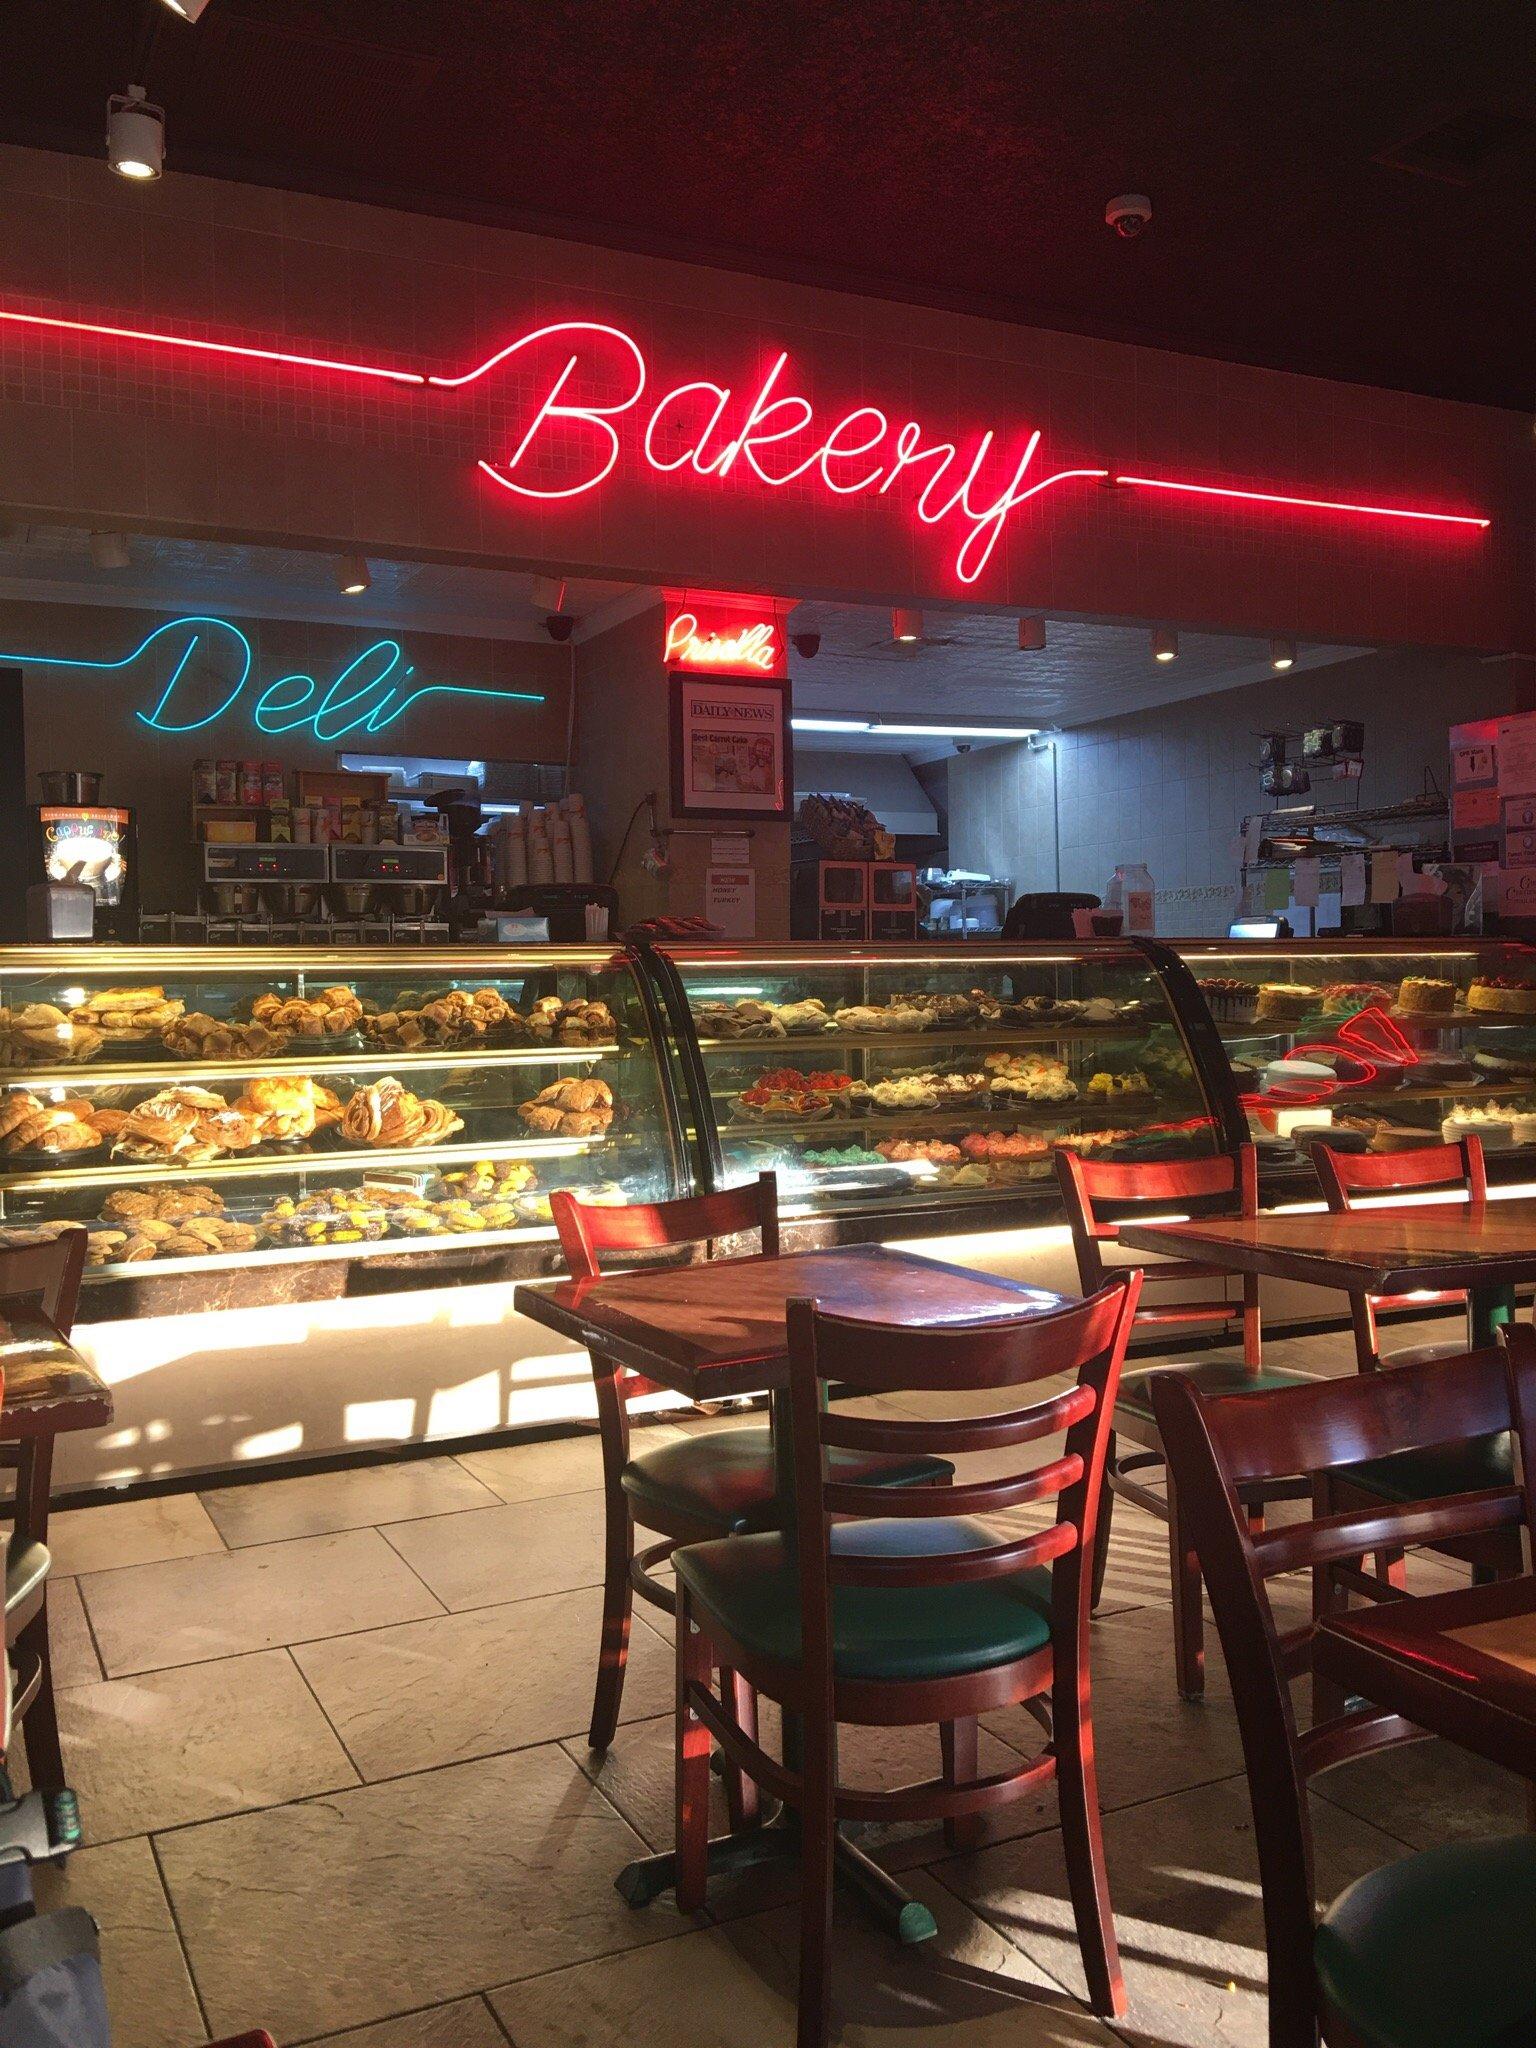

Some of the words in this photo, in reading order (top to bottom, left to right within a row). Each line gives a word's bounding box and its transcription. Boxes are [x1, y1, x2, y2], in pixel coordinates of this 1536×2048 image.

[455, 320, 1078, 585] Bakery
[128, 616, 430, 741] Deli
[692, 704, 732, 717] DAILY
[734, 706, 773, 720] NEWS
